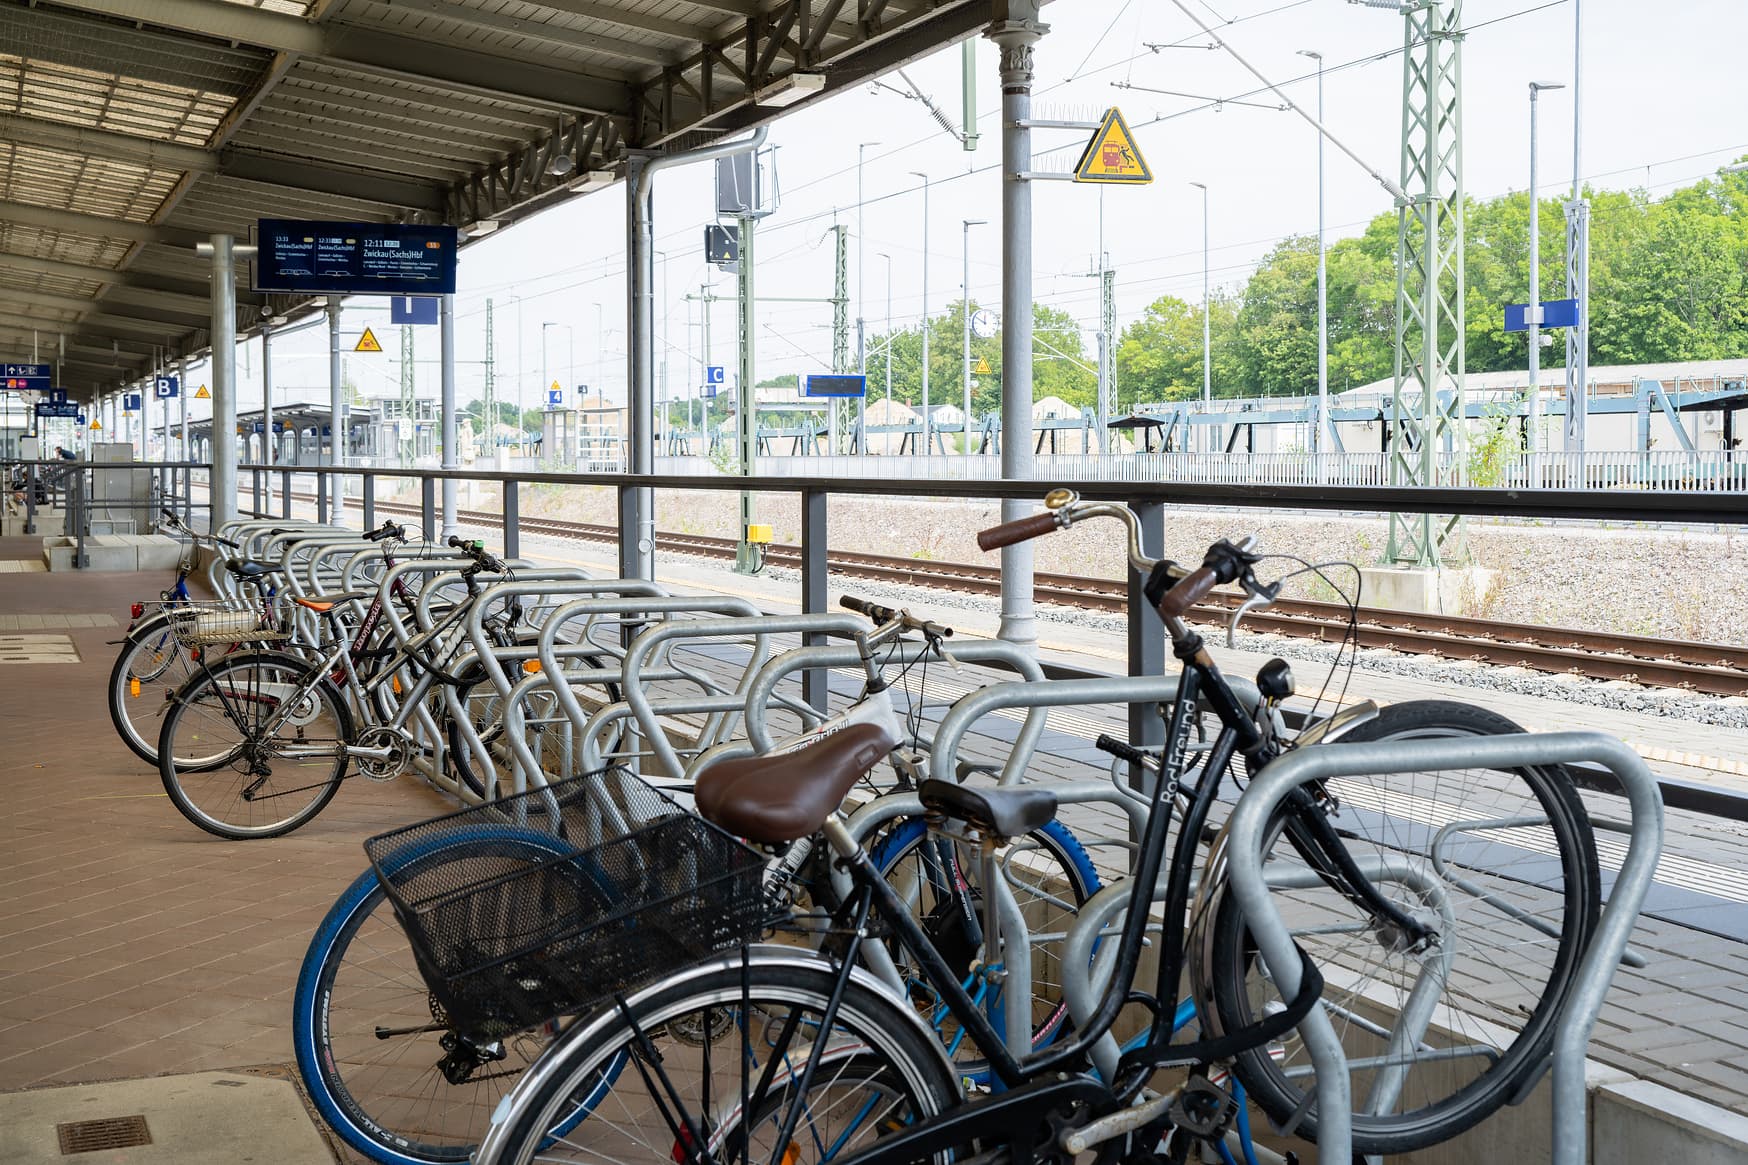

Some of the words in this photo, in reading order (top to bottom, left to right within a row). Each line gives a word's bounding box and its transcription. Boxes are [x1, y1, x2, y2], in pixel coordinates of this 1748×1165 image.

[713, 368, 723, 382] C
[158, 379, 170, 395] B
[125, 395, 132, 408] 1
[554, 391, 561, 402] 4
